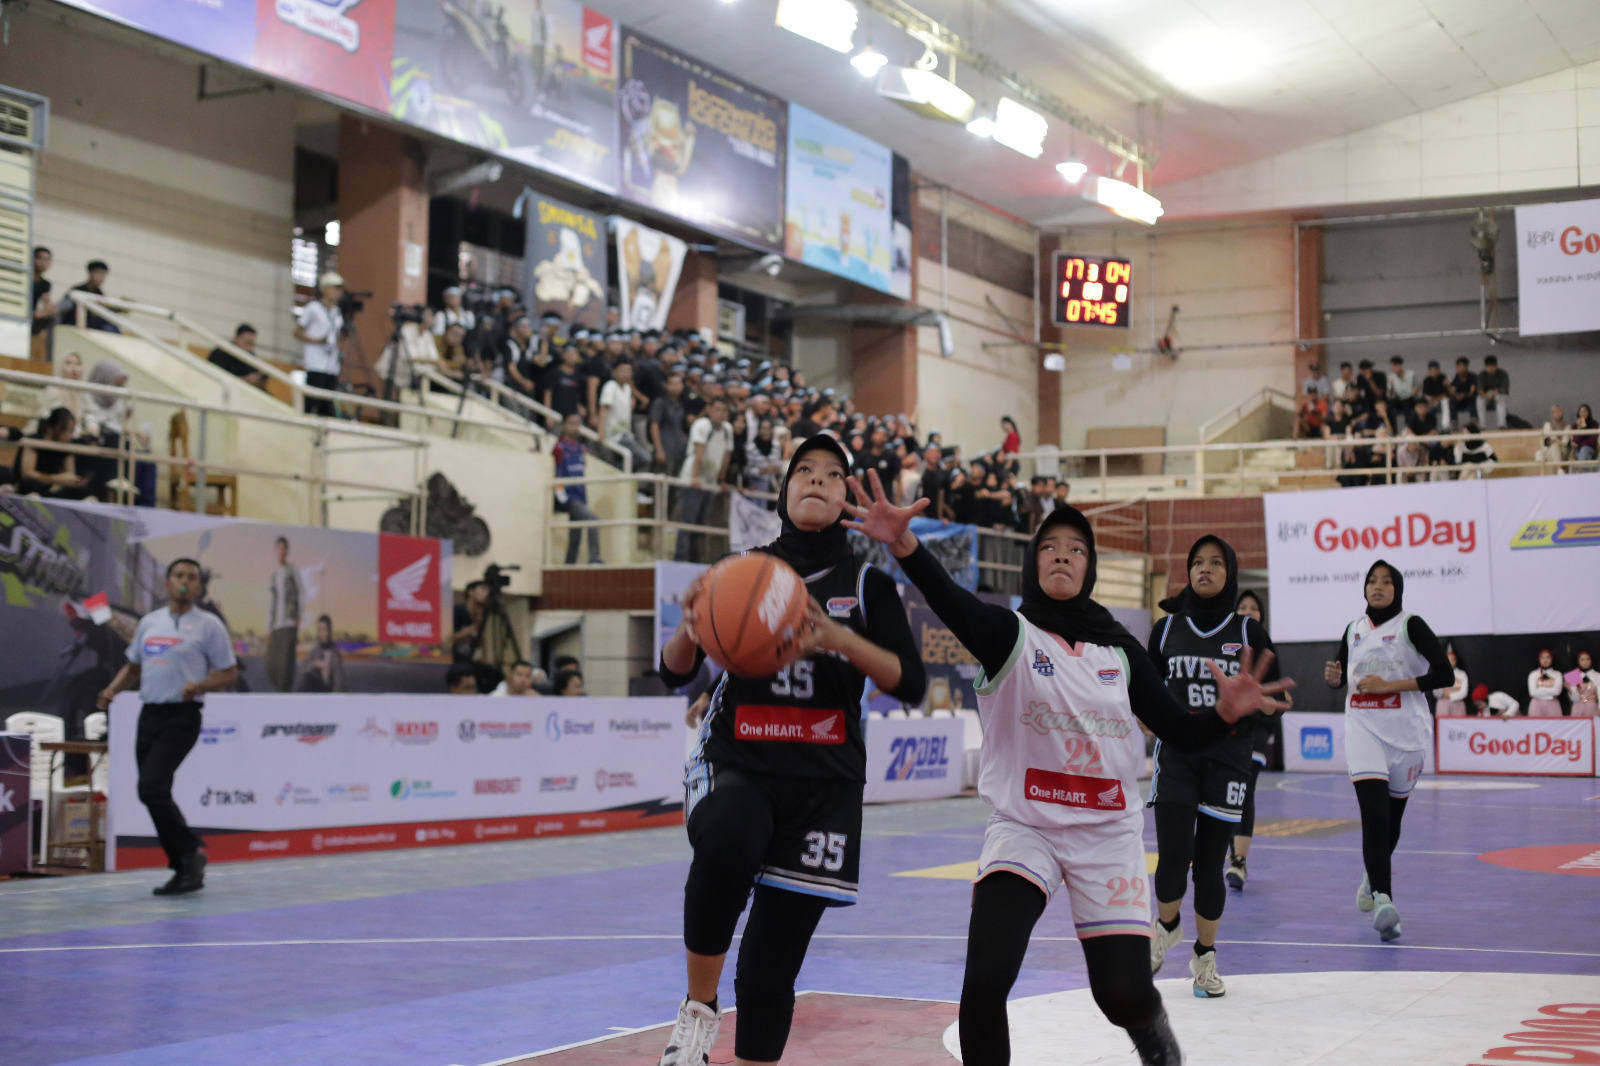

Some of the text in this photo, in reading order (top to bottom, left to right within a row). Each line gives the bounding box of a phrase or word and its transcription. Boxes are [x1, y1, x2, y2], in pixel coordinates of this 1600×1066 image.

[1066, 258, 1084, 281] 17
[1106, 261, 1131, 284] 04
[1066, 299, 1118, 325] 07:45
[1402, 569, 1433, 579] ANYAK
[1188, 682, 1216, 707] 66
[740, 721, 763, 735] One
[1063, 738, 1103, 777] 22
[1029, 785, 1051, 798] One
[1226, 781, 1247, 806] 66
[801, 831, 847, 872] 35
[1106, 876, 1147, 909] 22
